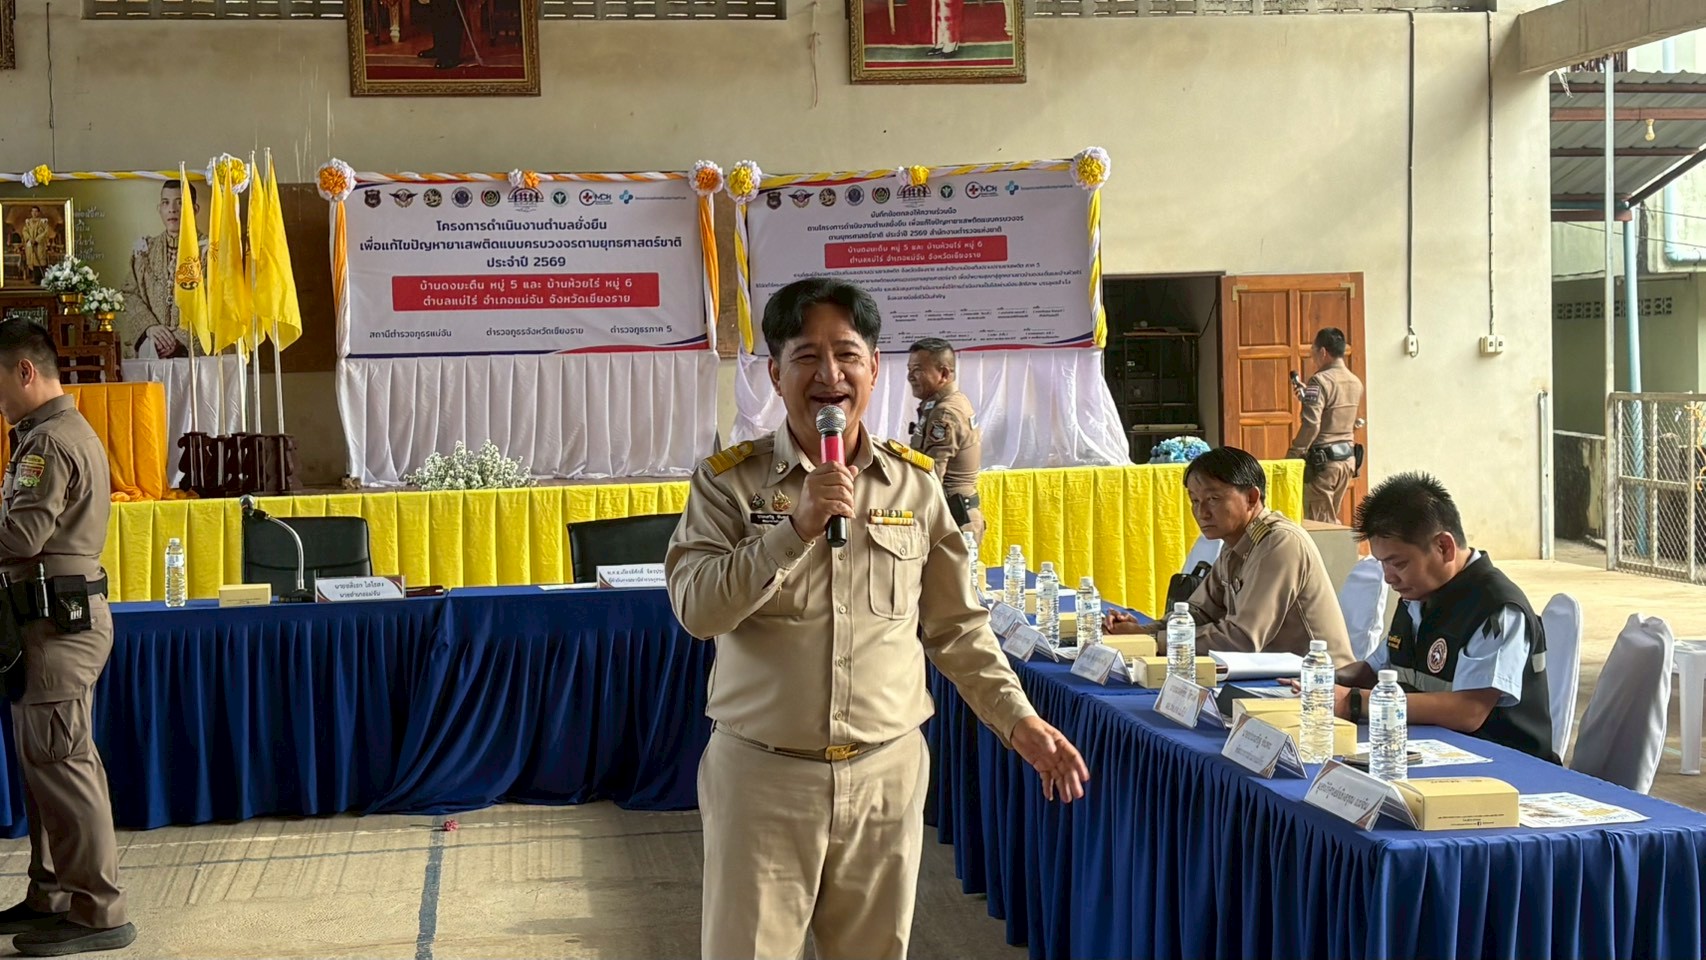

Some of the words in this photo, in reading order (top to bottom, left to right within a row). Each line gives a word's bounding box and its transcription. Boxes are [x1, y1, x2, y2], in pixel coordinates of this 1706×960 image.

[436, 215, 607, 232] โครงการดำเนินงานตำบลยั่งยืน
[360, 235, 682, 252] เพื่อแก้ไขปัญหายาเสพติดแบบครบวงจรตามยุทธศาสตร์ชาติ
[486, 255, 529, 268] ประจำปี
[533, 255, 567, 268] 2569
[490, 277, 505, 291] หมู่
[510, 279, 518, 289] 5
[522, 281, 542, 289] และ
[547, 277, 600, 290] บ้านห้วยไร่
[605, 277, 620, 291] หมู่
[625, 278, 632, 288] 6
[423, 294, 478, 306] ตำบลแม่ไร่
[483, 293, 543, 305] อำเภอแม่จัน
[549, 292, 631, 304] จังหวัดเชียงราย
[369, 328, 452, 340] สถานีตำรวจภูธรแม่จัน
[486, 326, 584, 338] ตำรวจภูธรจังหวัดเชียงราย
[610, 324, 664, 336] ตำรวจภูธรภาค
[666, 325, 673, 333] 5
